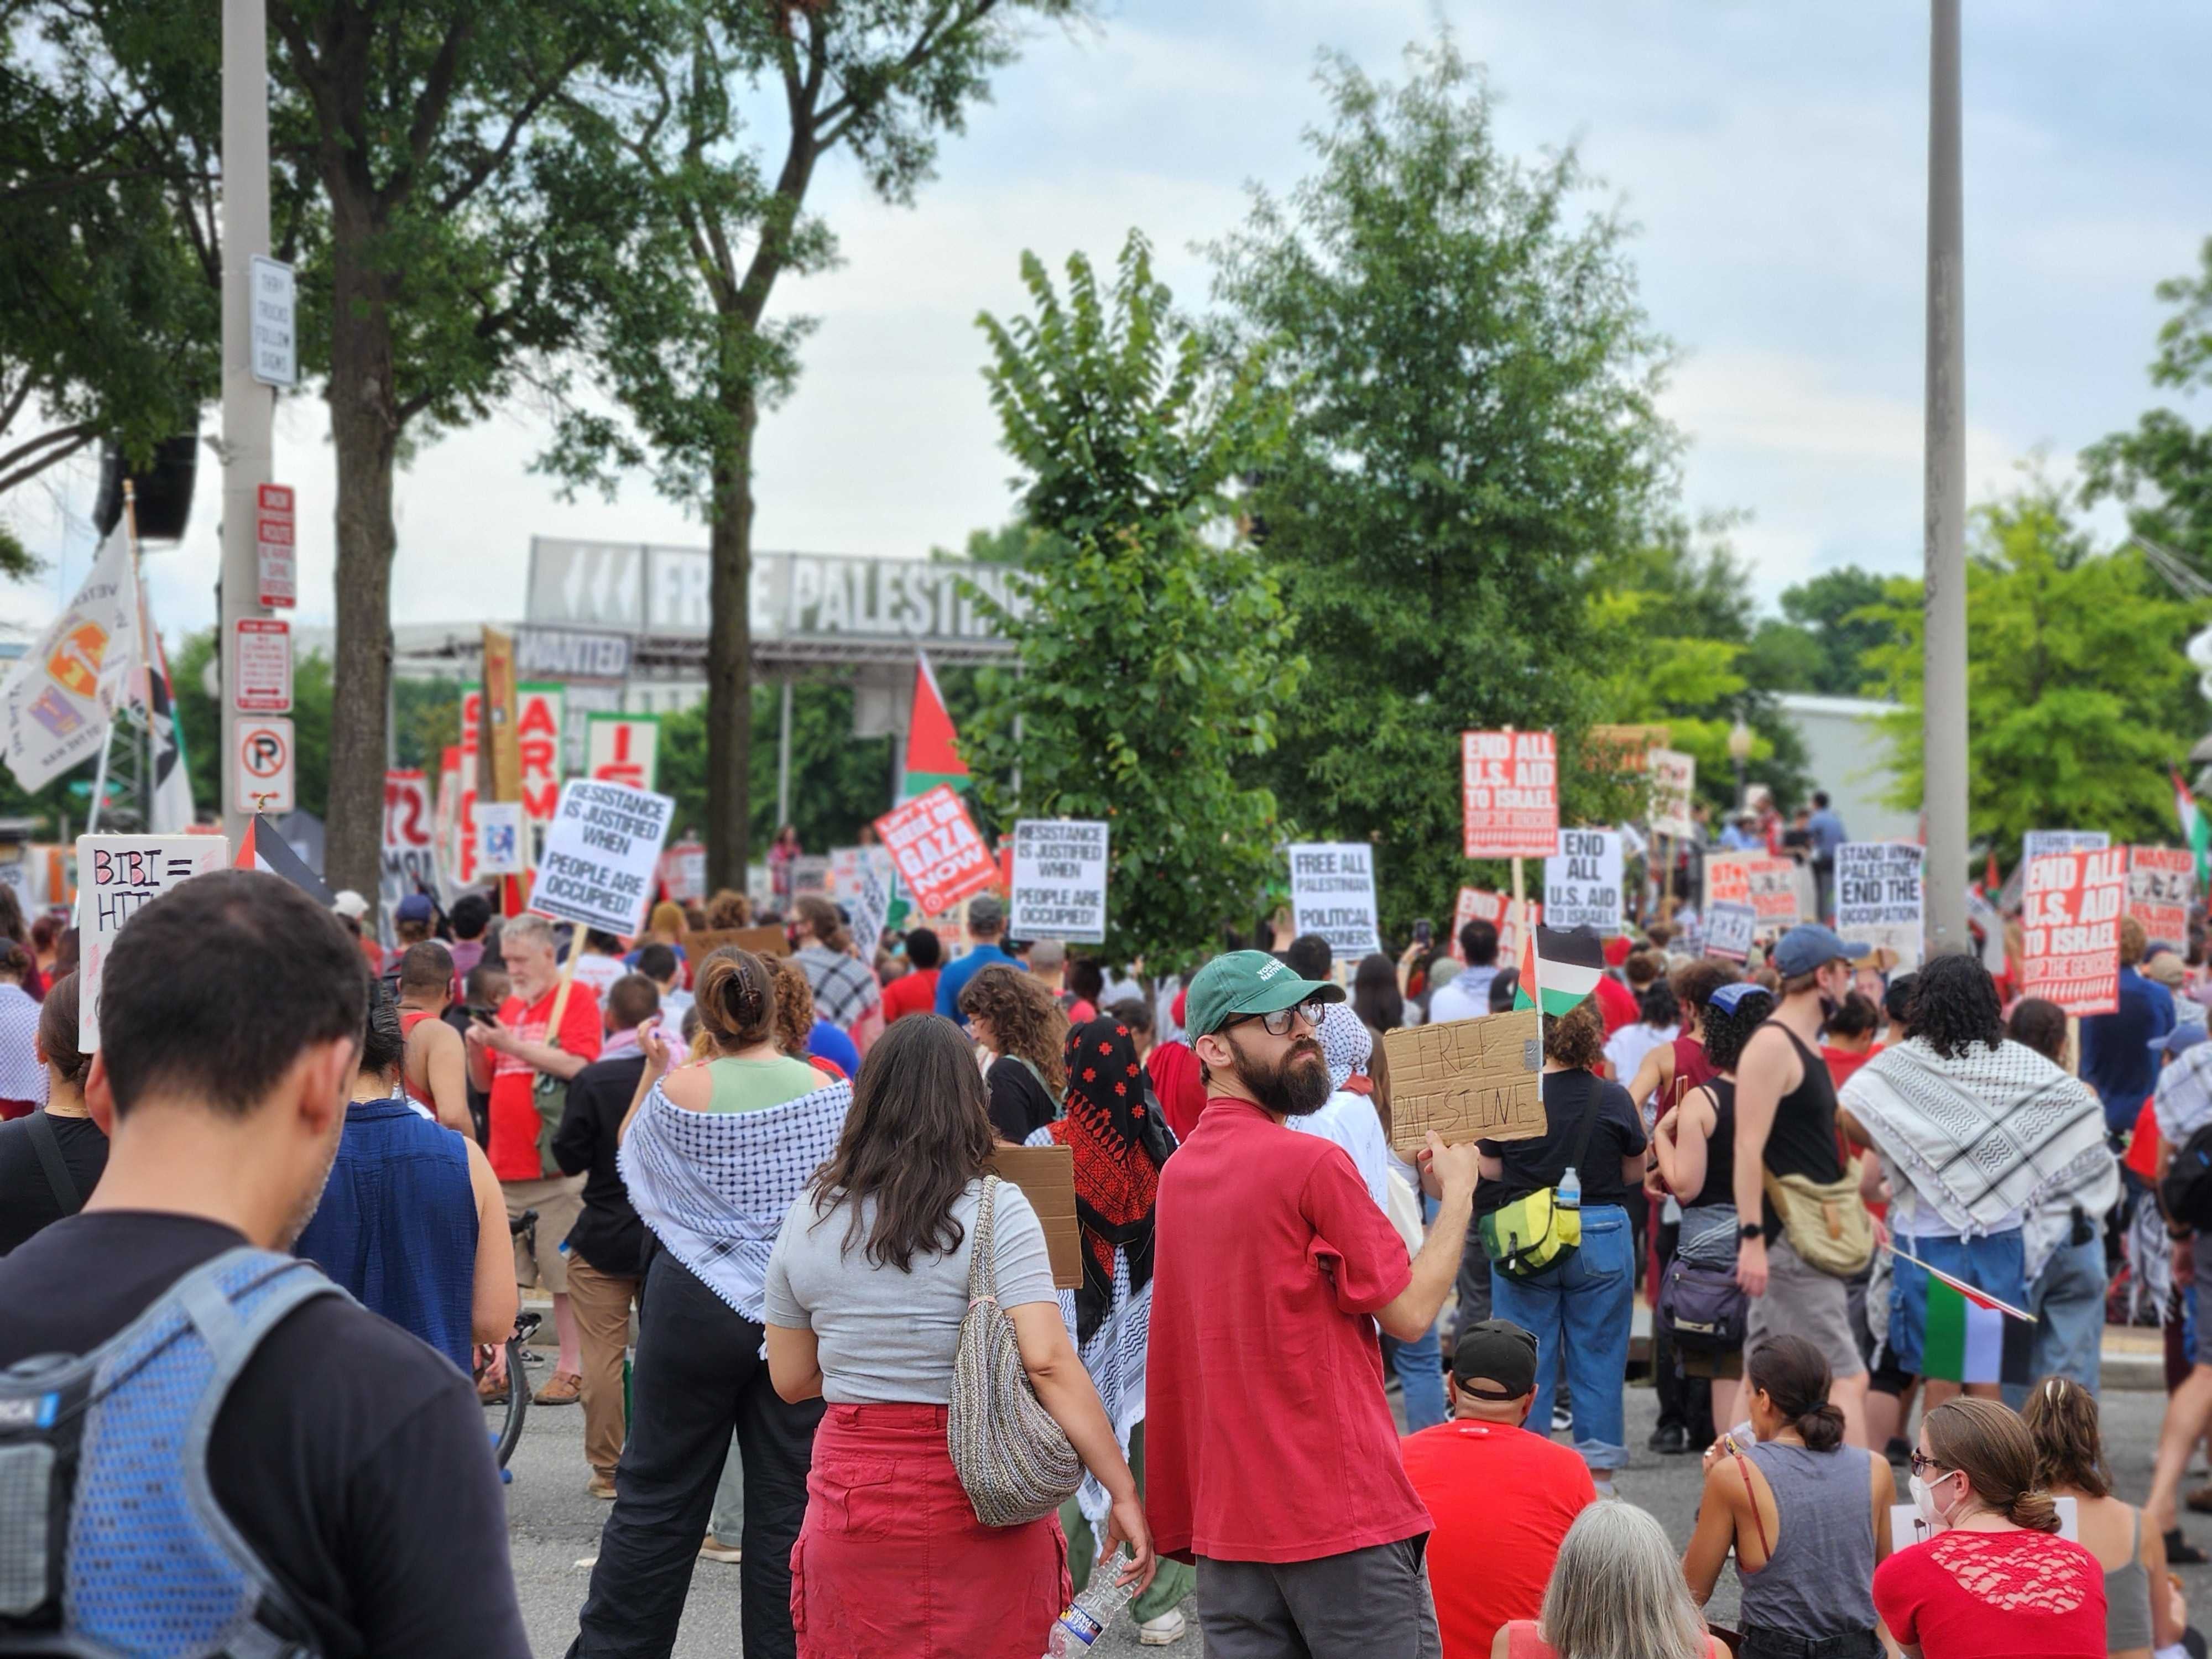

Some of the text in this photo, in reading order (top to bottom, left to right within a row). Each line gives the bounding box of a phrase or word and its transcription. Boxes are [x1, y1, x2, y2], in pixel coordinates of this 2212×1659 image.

[1466, 734, 1511, 760] END
[1515, 734, 1555, 760] ALL
[1465, 761, 1554, 786] U.S. AID
[569, 781, 665, 821] RESISTANCE
[1467, 789, 1555, 808] TO ISRAEL
[564, 800, 660, 841] IS JUSTIFIED
[582, 825, 632, 855] WHEN
[1018, 825, 1102, 842] RESISTANCE
[1564, 833, 1604, 857] END
[898, 818, 977, 877] GAZA
[1018, 843, 1102, 860] IS JUSTIFIED
[1840, 845, 1884, 860] STAND
[93, 849, 162, 887] BIBI
[546, 851, 645, 896] PEOPLE ARE
[912, 844, 983, 896] NOW
[1037, 861, 1082, 879] WHEN
[1295, 853, 1367, 874] FREE ALL
[1566, 858, 1602, 881] ALL
[2027, 850, 2123, 894] END ALL
[546, 874, 634, 916] OCCUPIED!
[1016, 887, 1102, 907] PEOPLE ARE
[1549, 886, 1616, 908] U.S. AID
[1841, 879, 1919, 904] END THE
[1020, 906, 1095, 925] OCCUPIED!
[1459, 889, 1500, 920] END
[1548, 908, 1564, 923] TO
[1840, 907, 1919, 924] OCCUPATION
[2025, 886, 2120, 929] U.S. AID
[1300, 907, 1372, 928] POLITICAL
[2023, 928, 2046, 957] TO
[2049, 921, 2119, 956] ISRAEL
[1417, 1019, 1501, 1078] FREE
[1393, 1081, 1540, 1152] PALESTINE
[1068, 1615, 1089, 1635] DEER
